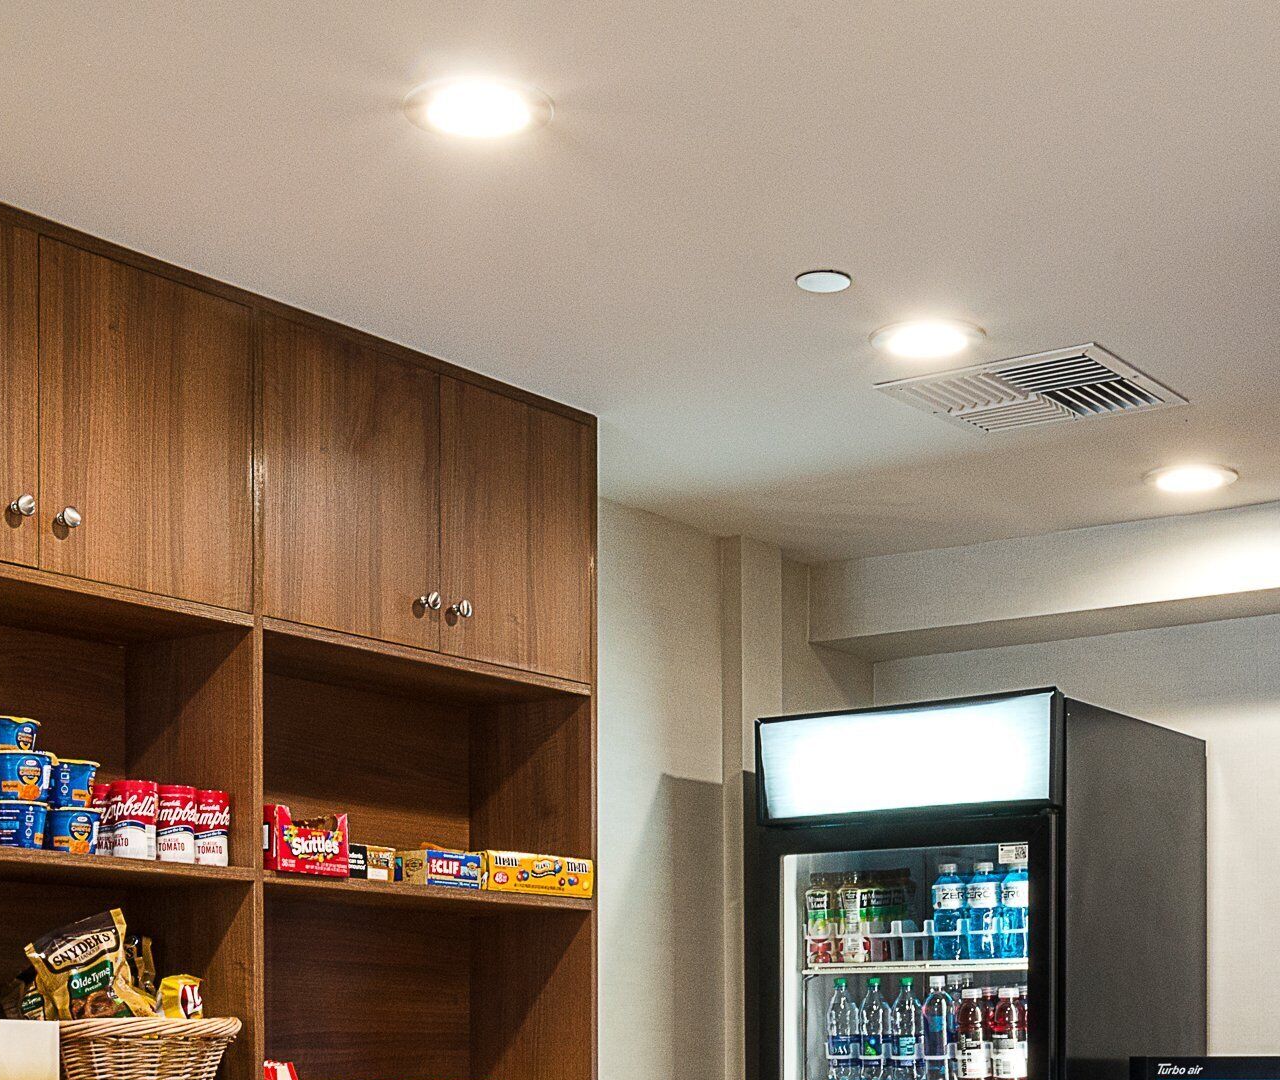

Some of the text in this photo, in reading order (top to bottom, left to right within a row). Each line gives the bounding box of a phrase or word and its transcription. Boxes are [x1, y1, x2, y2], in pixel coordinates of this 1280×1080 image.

[158, 842, 185, 852] TOMATO
[197, 845, 223, 855] TOMATO
[292, 834, 340, 856] Skittles
[436, 859, 460, 875] CLIF
[942, 892, 965, 900] ZER
[1157, 1063, 1203, 1075] Turbo air
